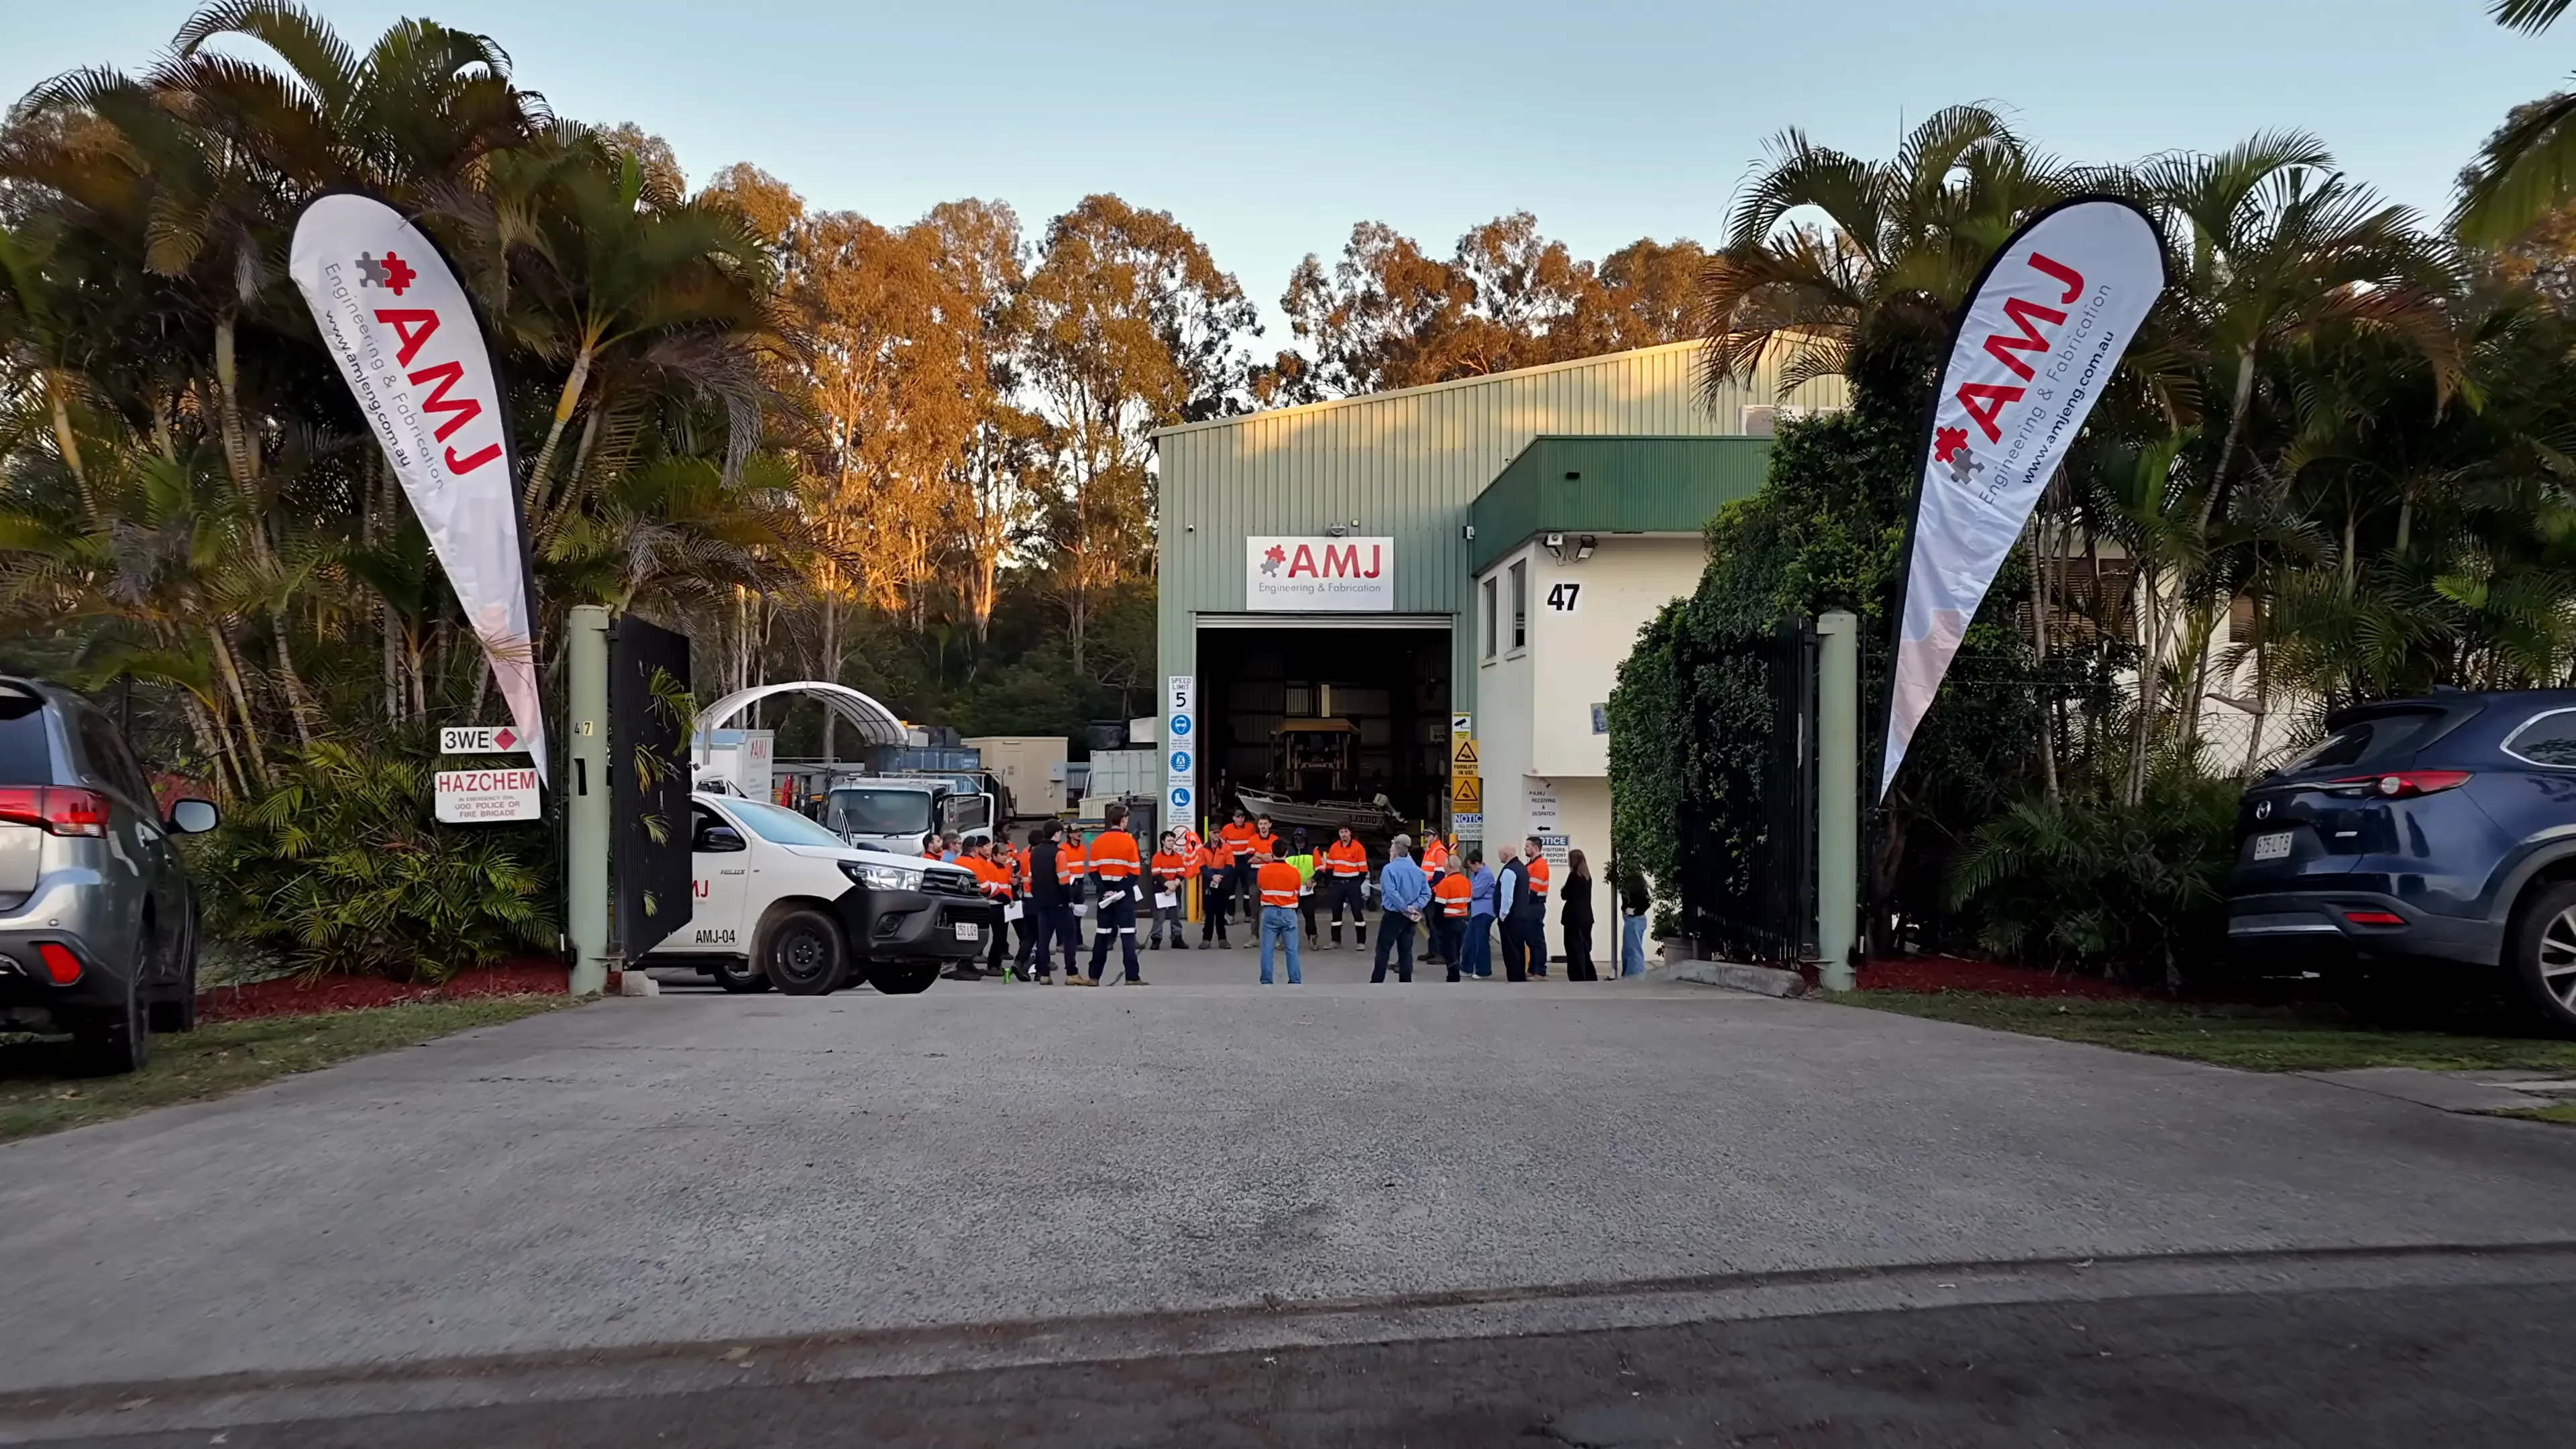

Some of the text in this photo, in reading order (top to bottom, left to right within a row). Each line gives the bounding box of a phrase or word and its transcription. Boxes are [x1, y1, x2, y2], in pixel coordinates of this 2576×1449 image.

[1955, 252, 2085, 445] AMJ
[325, 262, 444, 490] Engineering & Fabrication
[325, 309, 411, 468] www.amjeng.com.au
[373, 309, 503, 476] AMJ
[1979, 284, 2112, 505] Engineering & Fabrication
[2022, 330, 2114, 485] www.amjeng.com.au
[1287, 544, 1381, 579] AMJ
[1258, 582, 1381, 594] Engineering & Fabrication
[1547, 584, 1580, 611] 47
[1176, 692, 1187, 708] 5
[444, 731, 490, 749] 3WE
[439, 771, 535, 793] HAZCHEM
[476, 801, 505, 809] POLICE
[480, 809, 515, 817] BRIGADE
[1454, 814, 1483, 823] NOTIC
[696, 929, 736, 944] AMJ-04
